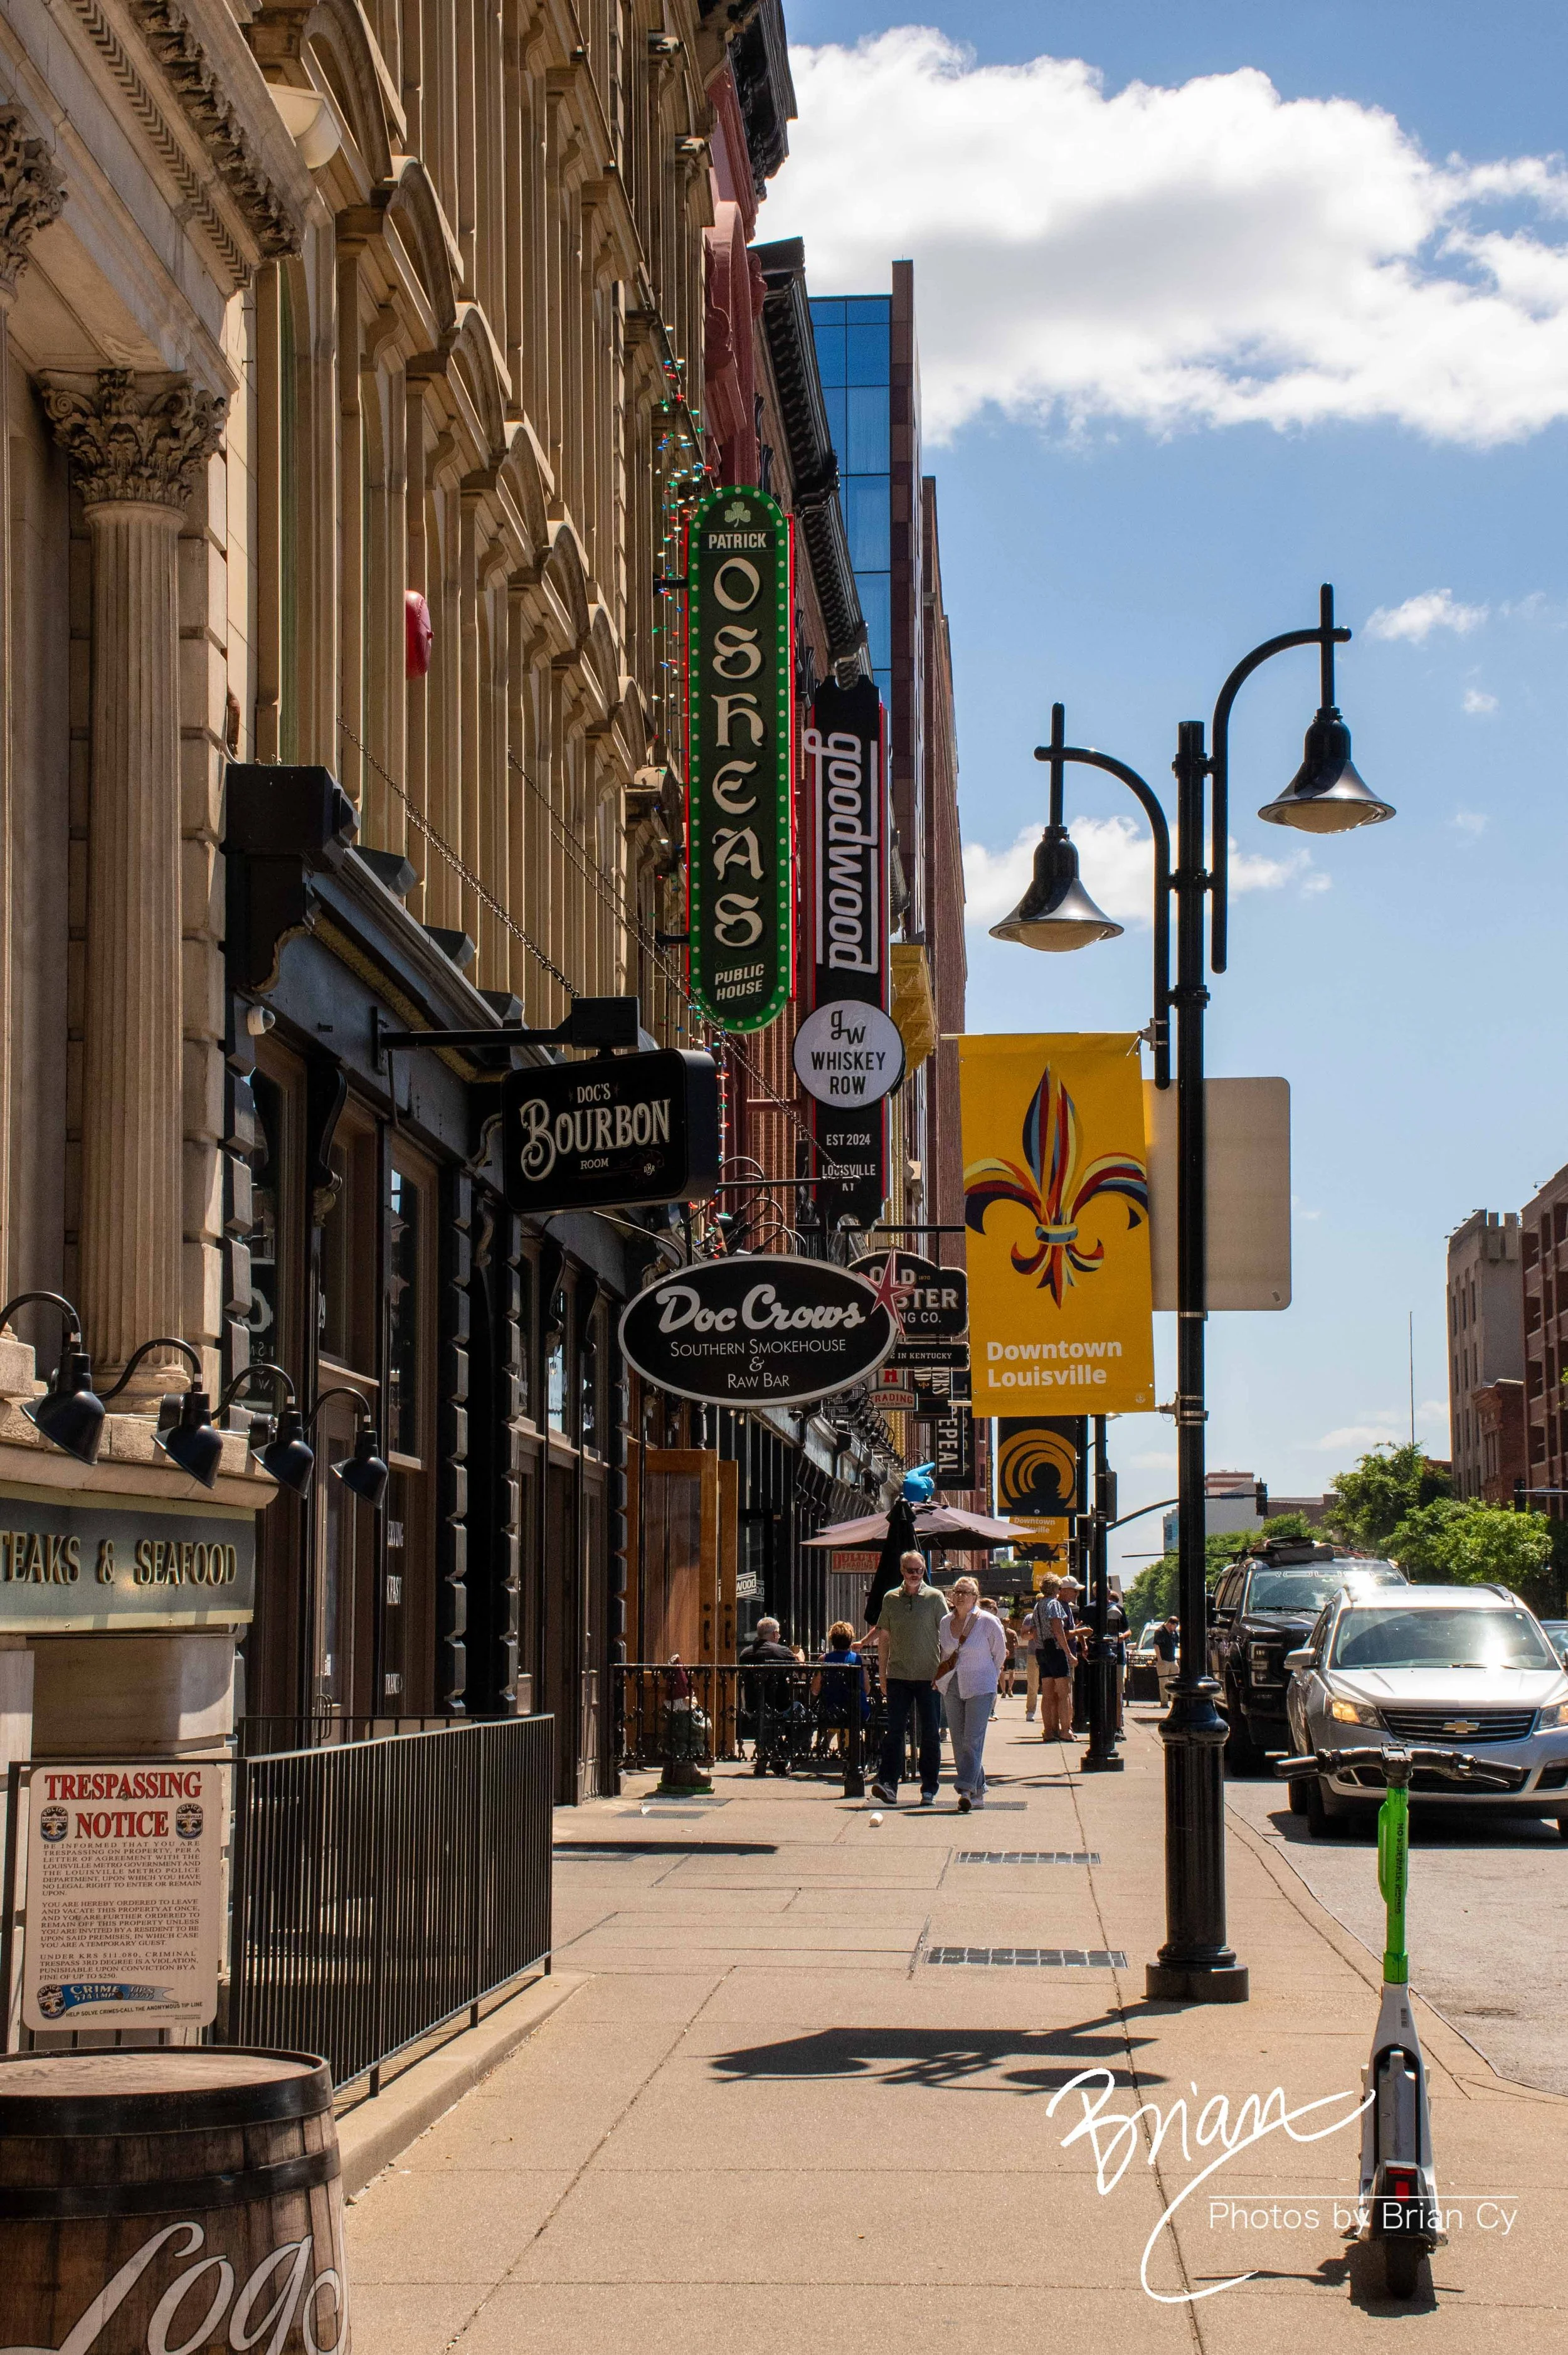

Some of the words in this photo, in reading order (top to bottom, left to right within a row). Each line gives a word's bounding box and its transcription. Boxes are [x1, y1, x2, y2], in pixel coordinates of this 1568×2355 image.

[709, 533, 766, 549] PATRICK
[803, 728, 878, 974] goodwood
[714, 964, 765, 985] PUBLIC
[716, 980, 763, 1001] HOUSE
[811, 1051, 886, 1071] WHISKEY
[577, 1083, 611, 1104] DOC'S
[830, 1076, 866, 1094] ROW
[519, 1098, 671, 1182] BOURBON
[826, 1134, 844, 1146] EST
[847, 1133, 871, 1145] 2024
[580, 1158, 609, 1170] ROOM
[869, 1266, 916, 1285] OD
[656, 1285, 738, 1333] Doc
[741, 1284, 866, 1331] Crows
[921, 1312, 941, 1323] CO.
[670, 1341, 744, 1357] SOUTHERN
[749, 1338, 846, 1355] SMOKEHOUSE
[987, 1341, 1122, 1361] Downtown
[749, 1356, 765, 1372] &
[728, 1373, 758, 1389] RAW
[763, 1372, 790, 1387] BAR
[988, 1365, 1107, 1387] Louisville
[1014, 1517, 1056, 1526] Downtown
[98, 1539, 117, 1584] &
[134, 1538, 237, 1585] SEAFOOD
[45, 1772, 202, 1801] TRESPASSING
[75, 1811, 169, 1839] NOTICE
[70, 1985, 120, 1994] CRIME
